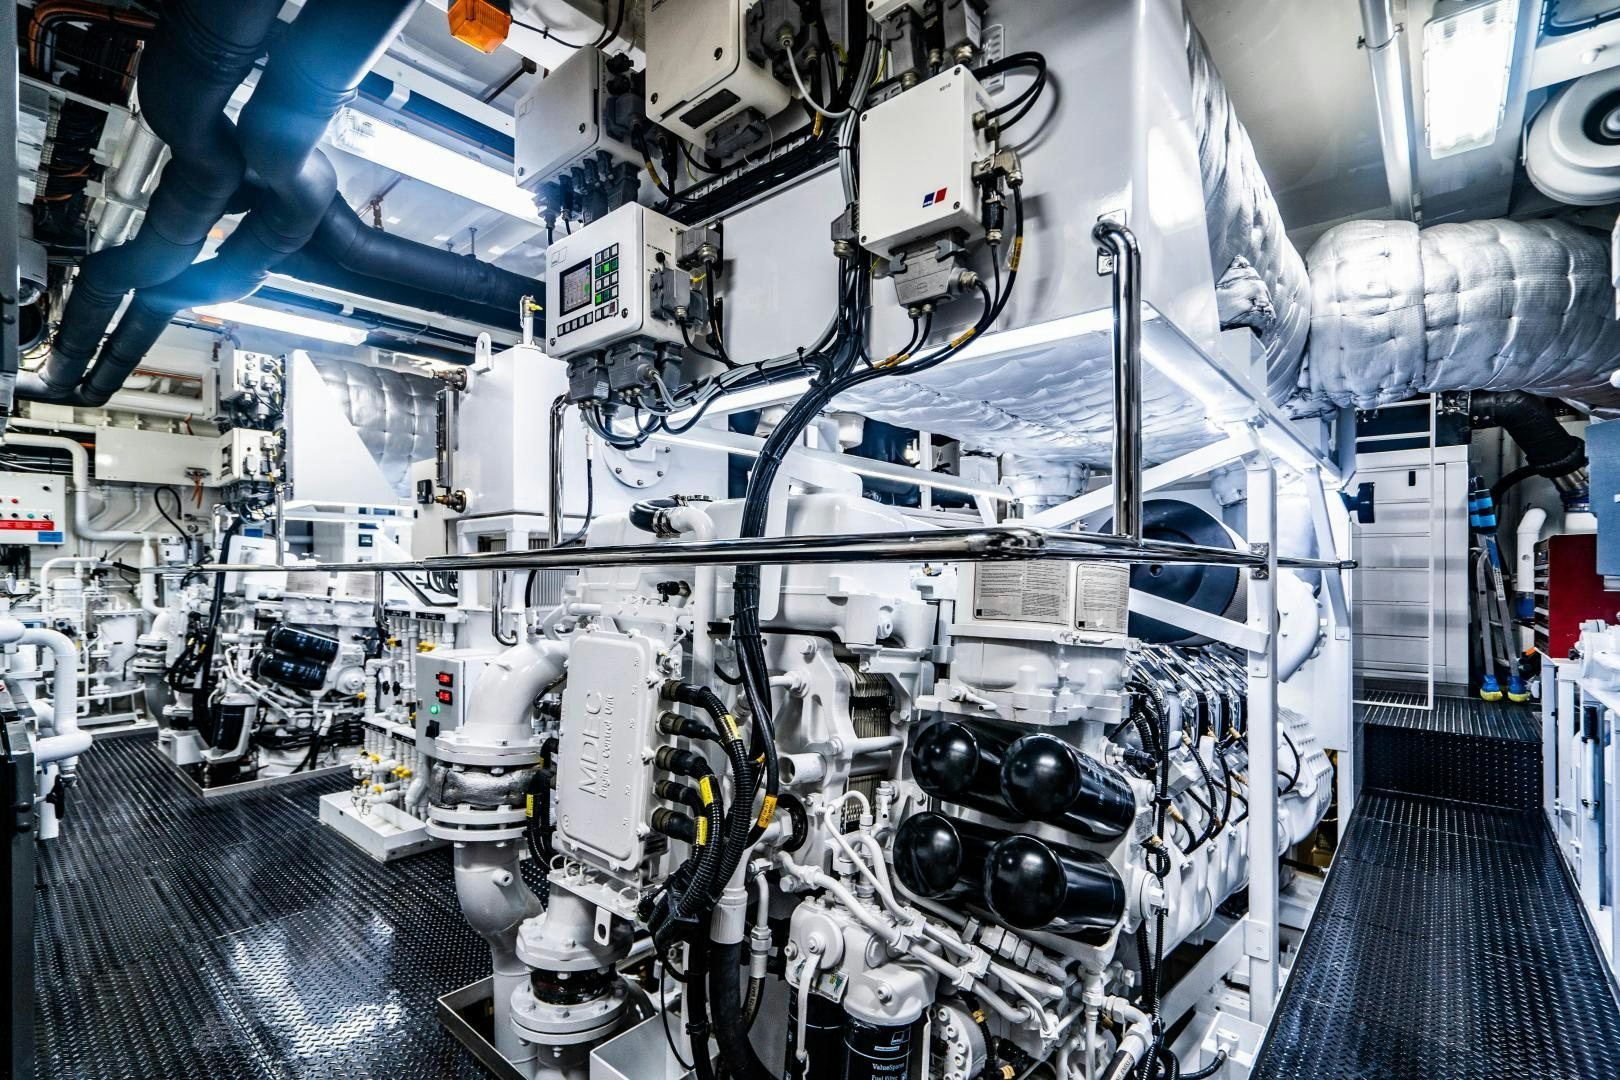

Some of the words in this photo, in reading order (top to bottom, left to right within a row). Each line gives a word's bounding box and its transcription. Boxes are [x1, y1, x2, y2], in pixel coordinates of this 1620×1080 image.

[604, 694, 615, 716] Unit
[578, 689, 602, 795] MDEC
[601, 721, 613, 759] Control
[598, 765, 610, 800] Engine
